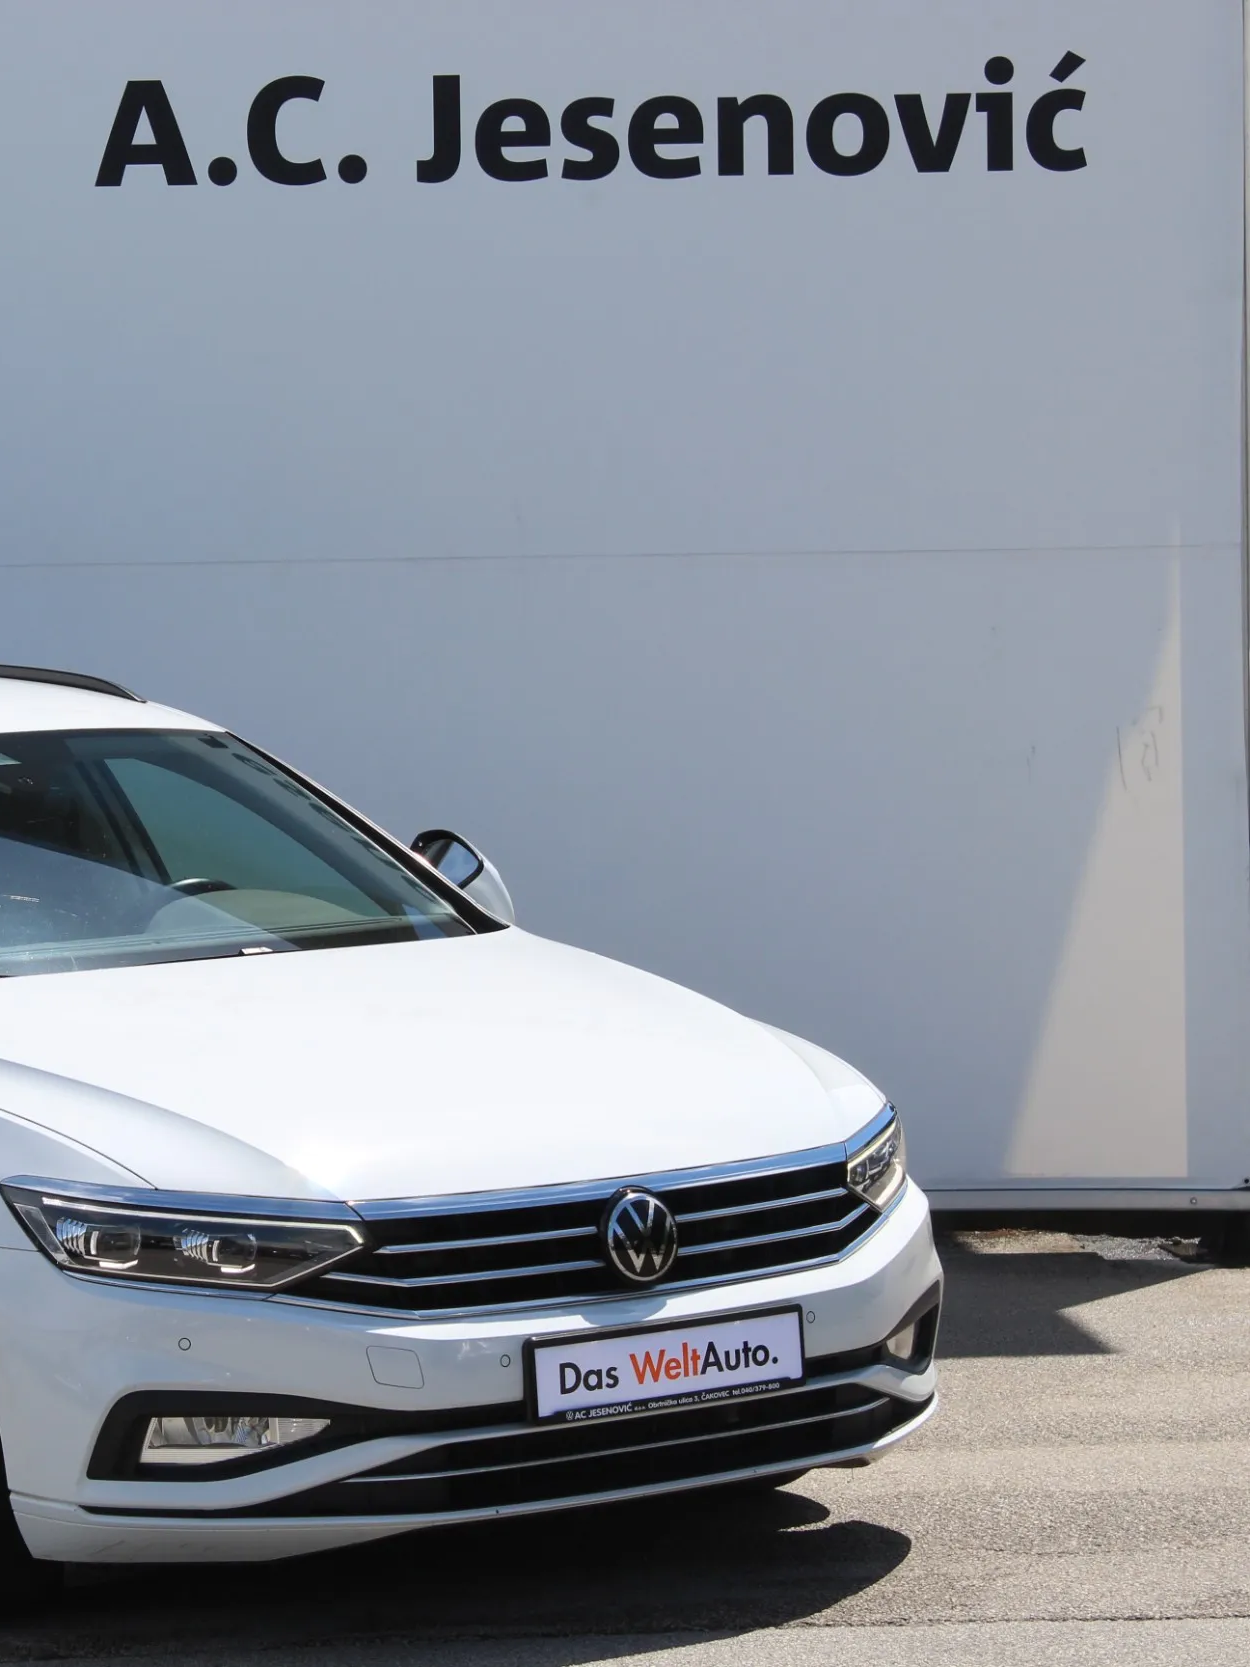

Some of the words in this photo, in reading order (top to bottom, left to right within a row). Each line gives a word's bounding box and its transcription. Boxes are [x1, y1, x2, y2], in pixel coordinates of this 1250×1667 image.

[94, 75, 368, 187] A.C.
[416, 50, 1088, 184] Jesenović
[559, 1361, 619, 1395] Das
[629, 1340, 779, 1385] WeltAuto.
[574, 1410, 587, 1420] AC
[588, 1402, 633, 1418] JESENOVIĆ
[678, 1396, 693, 1405] ulica
[700, 1389, 730, 1401] ČAKOVEC
